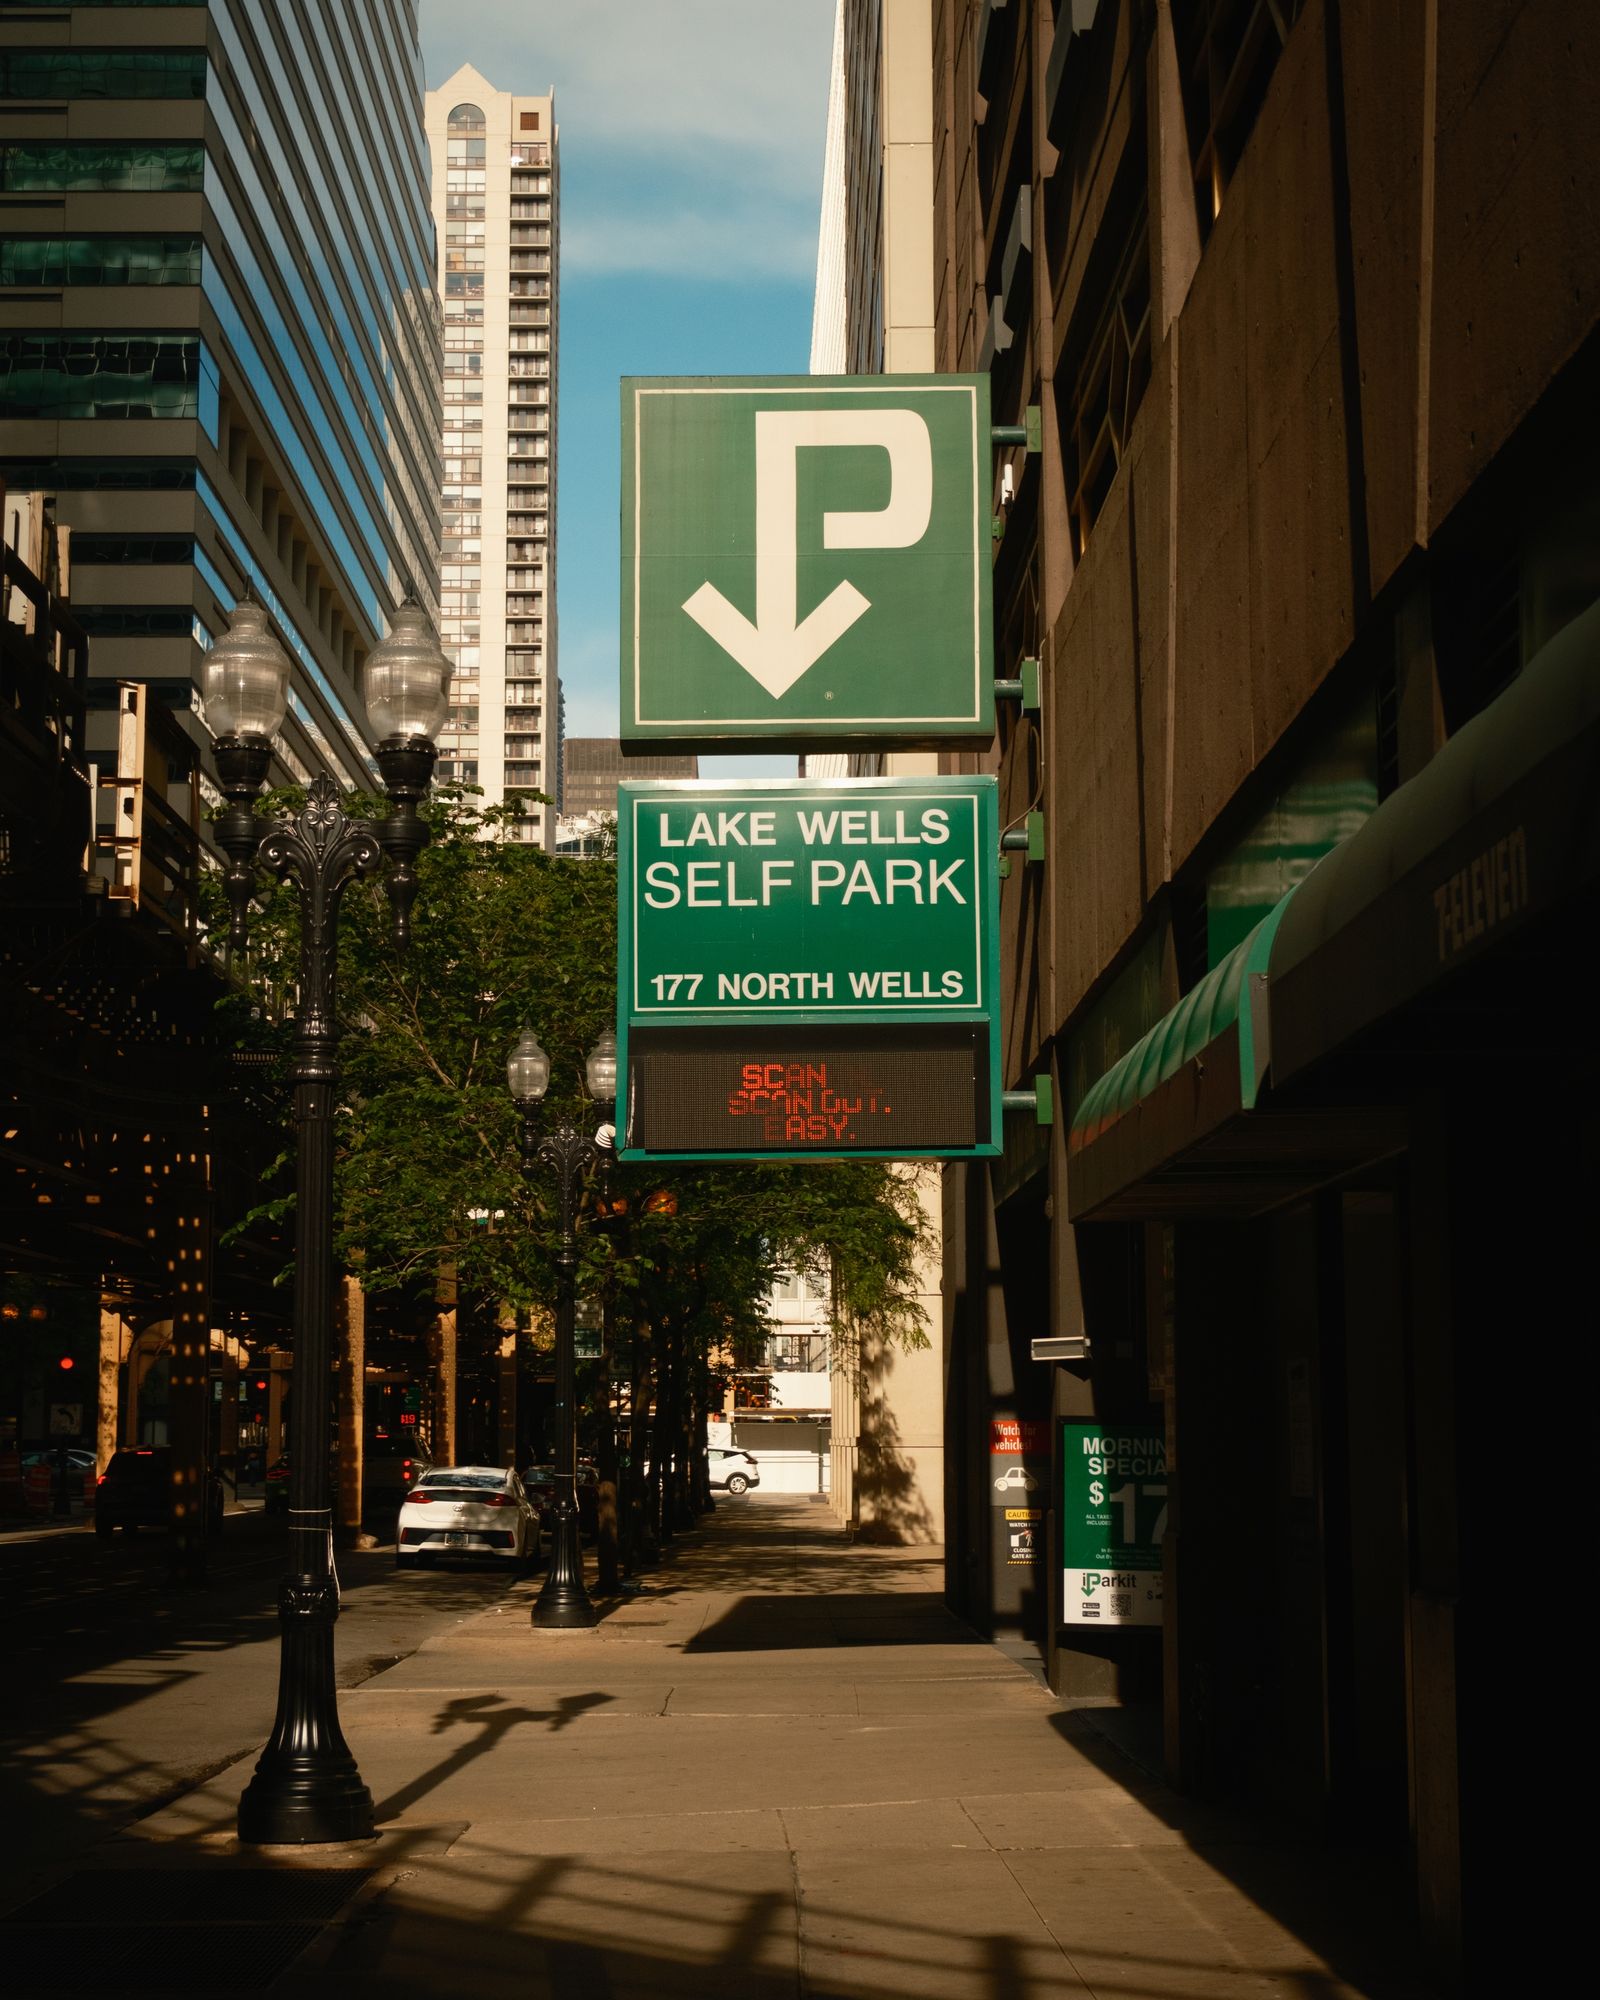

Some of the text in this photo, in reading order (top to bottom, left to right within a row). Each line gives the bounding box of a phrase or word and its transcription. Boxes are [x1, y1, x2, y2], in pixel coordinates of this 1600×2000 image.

[660, 809, 950, 847] LAKE WELLS
[644, 858, 967, 909] SELF PARK
[651, 970, 964, 1001] 177 NORTH WELLS
[742, 1063, 827, 1089] SCAN
[764, 1115, 857, 1141] EASY.
[994, 1423, 1021, 1437] Watch
[1082, 1437, 1166, 1456] MORNIN
[1088, 1457, 1168, 1476] SPECIA
[1082, 1573, 1136, 1590] iParkit
